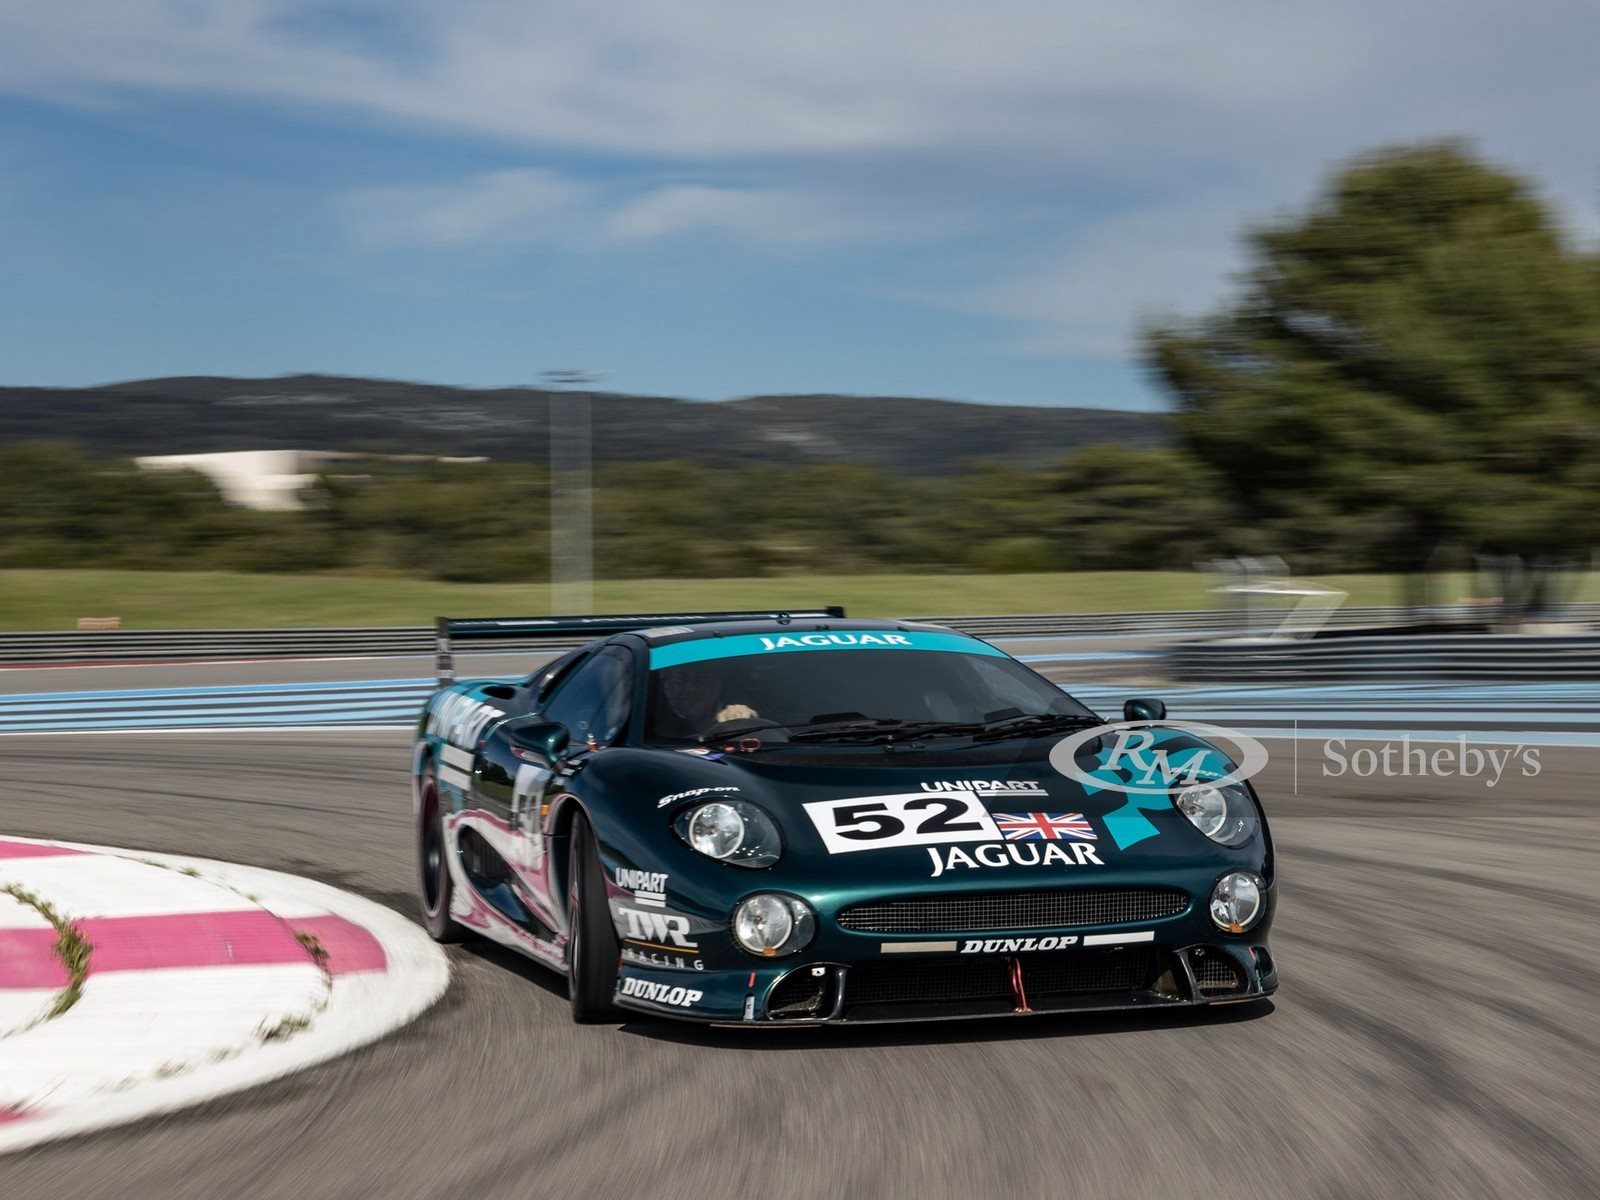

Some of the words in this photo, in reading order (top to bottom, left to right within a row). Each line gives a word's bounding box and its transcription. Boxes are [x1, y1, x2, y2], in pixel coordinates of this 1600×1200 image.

[760, 633, 913, 652] JAGUAR
[920, 780, 1039, 792] UNIPART
[833, 797, 984, 840] 52
[927, 842, 1105, 877] JAGUAR
[615, 867, 669, 893] UNIPART
[618, 907, 698, 948] TWR
[961, 936, 1078, 954] DUNLOP
[627, 948, 704, 971] RACING
[622, 977, 703, 1007] DUNLOP
